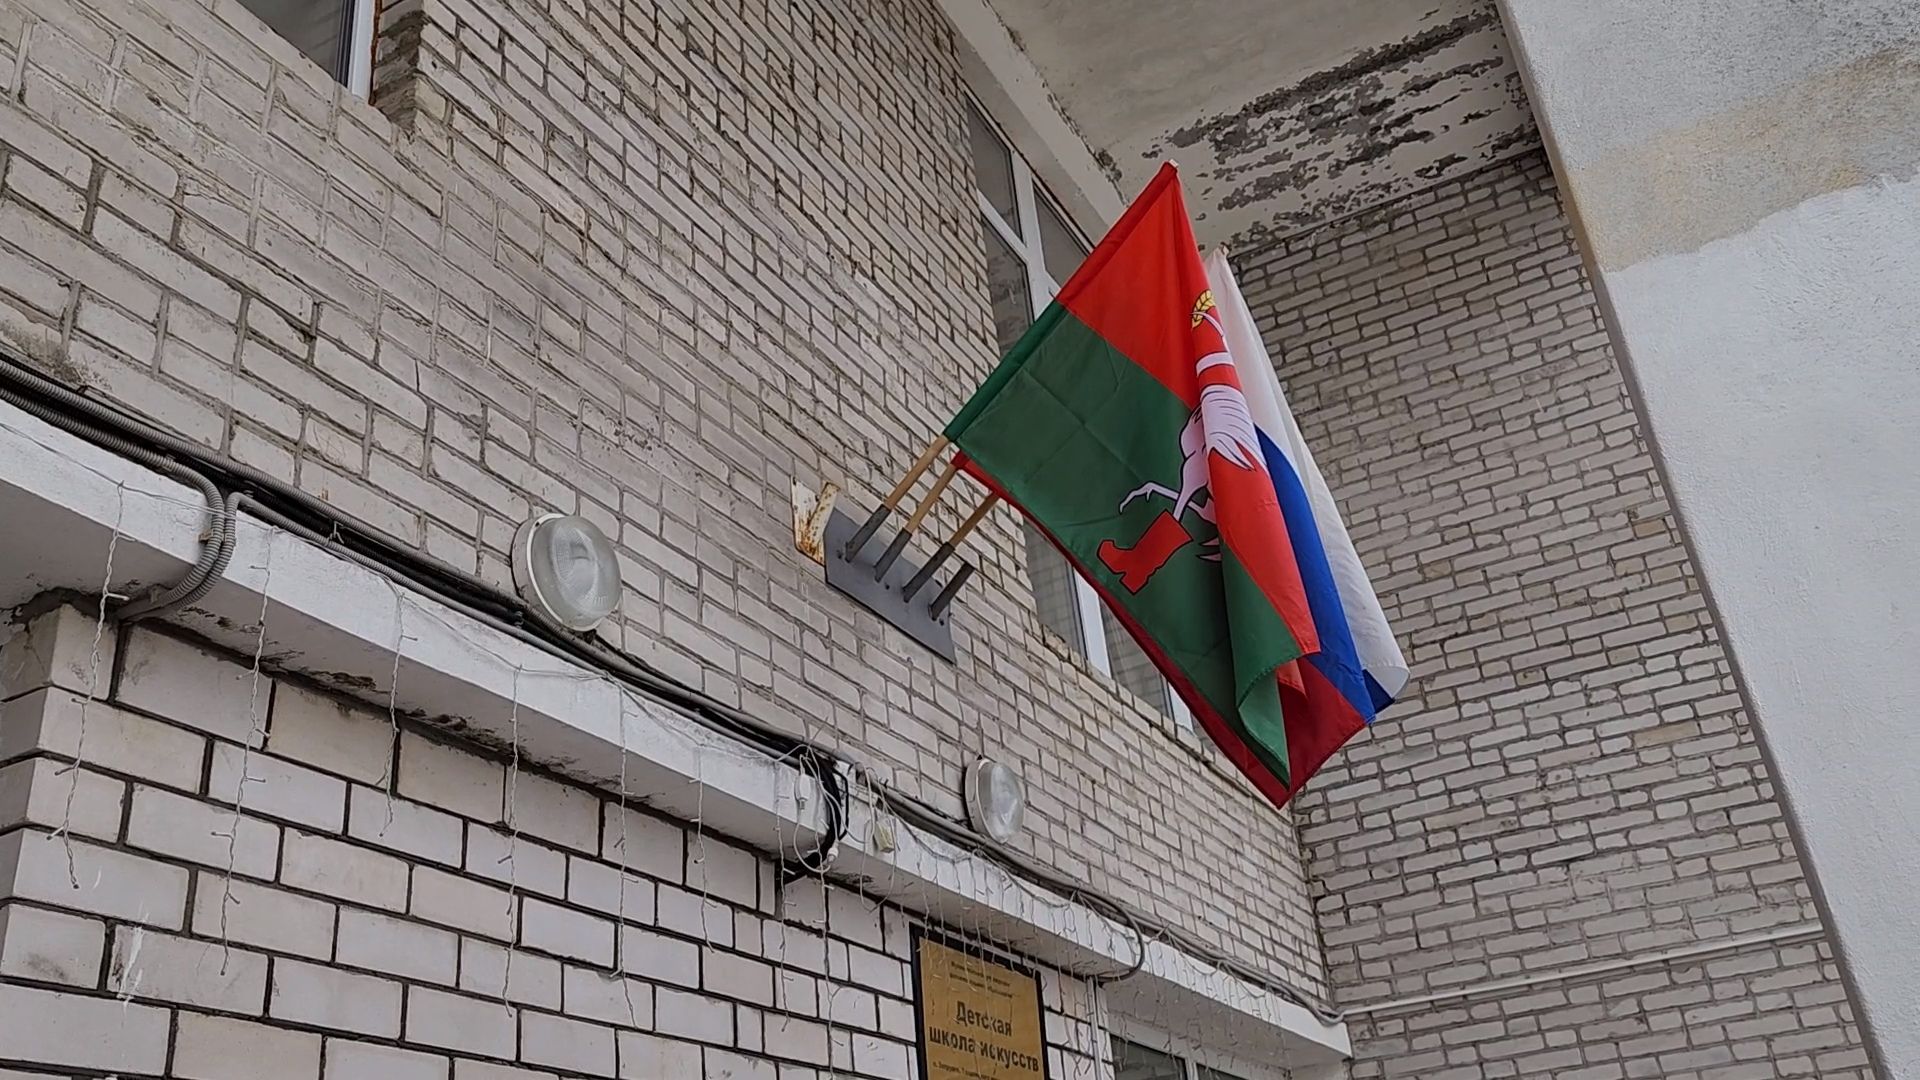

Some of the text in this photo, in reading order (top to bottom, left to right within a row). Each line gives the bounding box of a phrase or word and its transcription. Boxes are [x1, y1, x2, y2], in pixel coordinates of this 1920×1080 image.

[956, 1000, 1012, 1037] Детская
[929, 1026, 975, 1053] школа
[979, 1041, 1039, 1072] искусств
